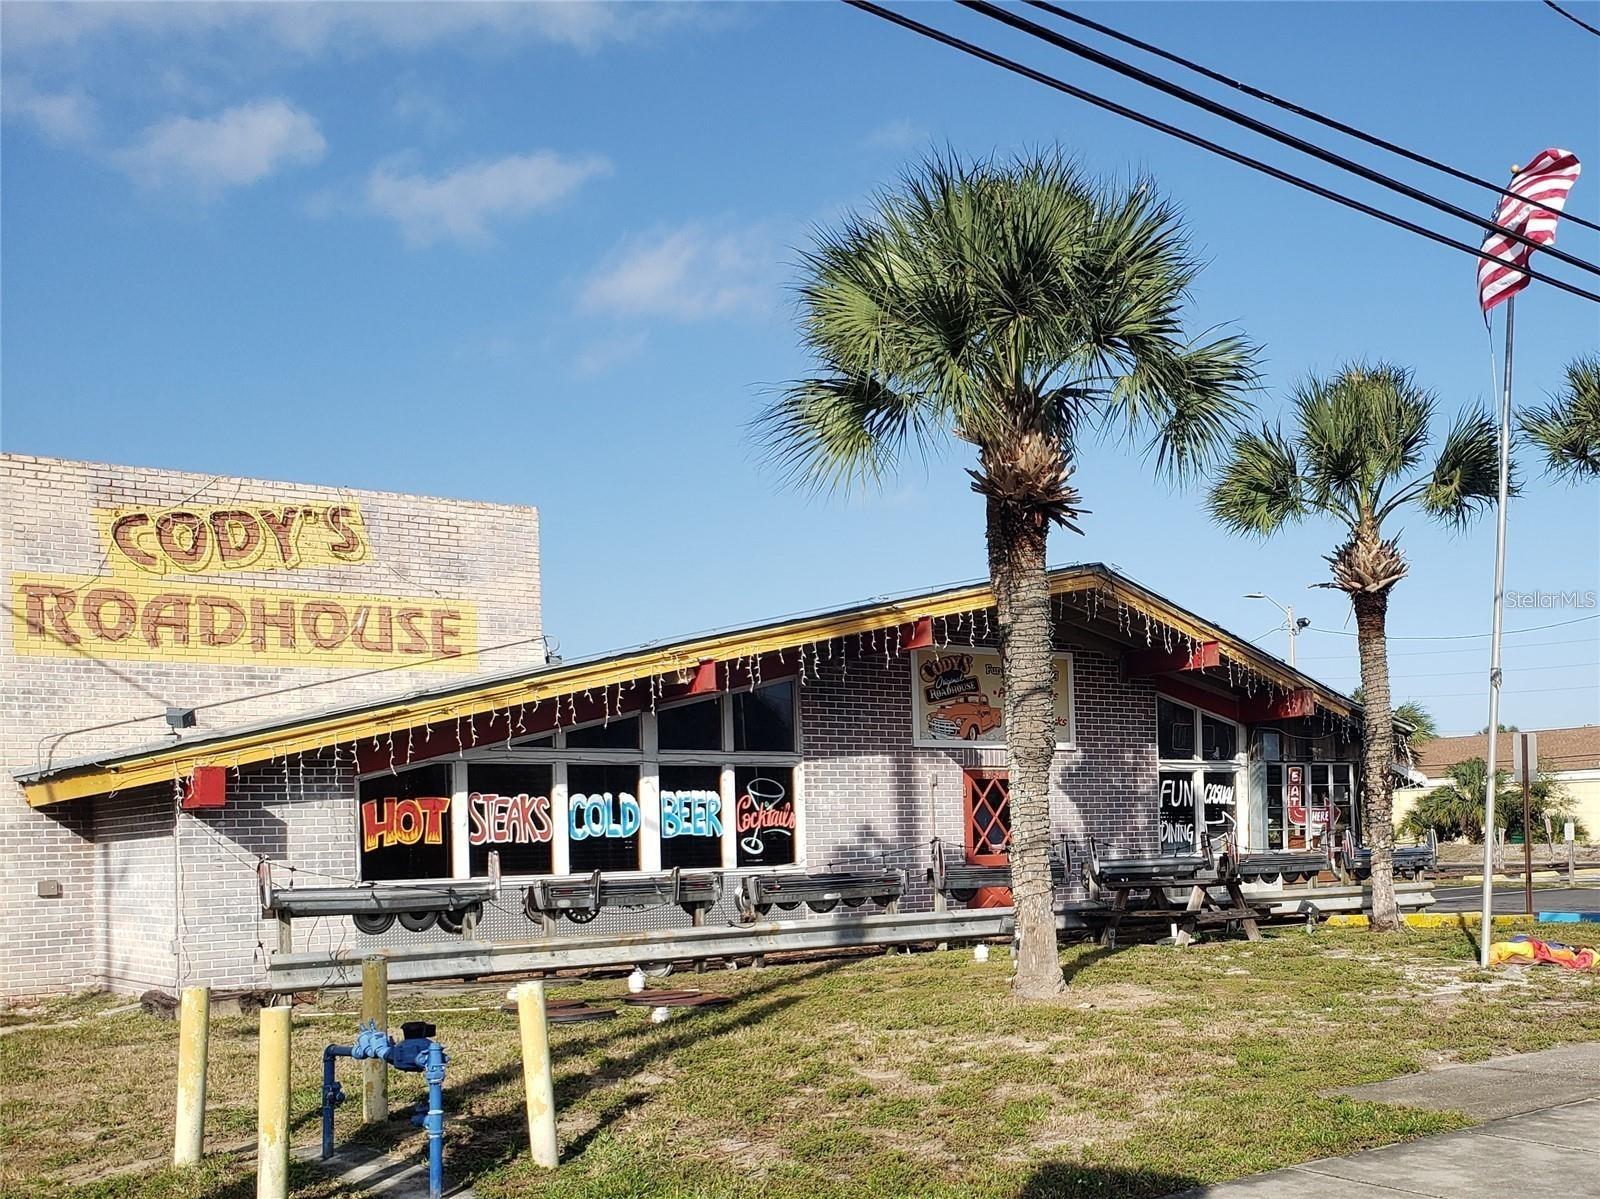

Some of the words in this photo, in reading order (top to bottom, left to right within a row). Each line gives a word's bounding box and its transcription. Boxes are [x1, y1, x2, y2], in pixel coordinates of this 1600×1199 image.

[109, 504, 366, 575] CODY'S
[17, 584, 463, 658] ROADHOUSE
[930, 681, 976, 700] ROADHOUSE
[1160, 779, 1194, 808] FUN
[1204, 782, 1236, 805] CASUAL
[1290, 771, 1300, 807] EAT
[362, 796, 451, 852] HOT
[468, 793, 553, 844] STEAKS
[568, 793, 642, 840] COLD
[660, 789, 725, 838] BEER
[736, 794, 797, 833] Cocktails
[1311, 810, 1329, 822] HERE
[1160, 820, 1194, 845] DINING
